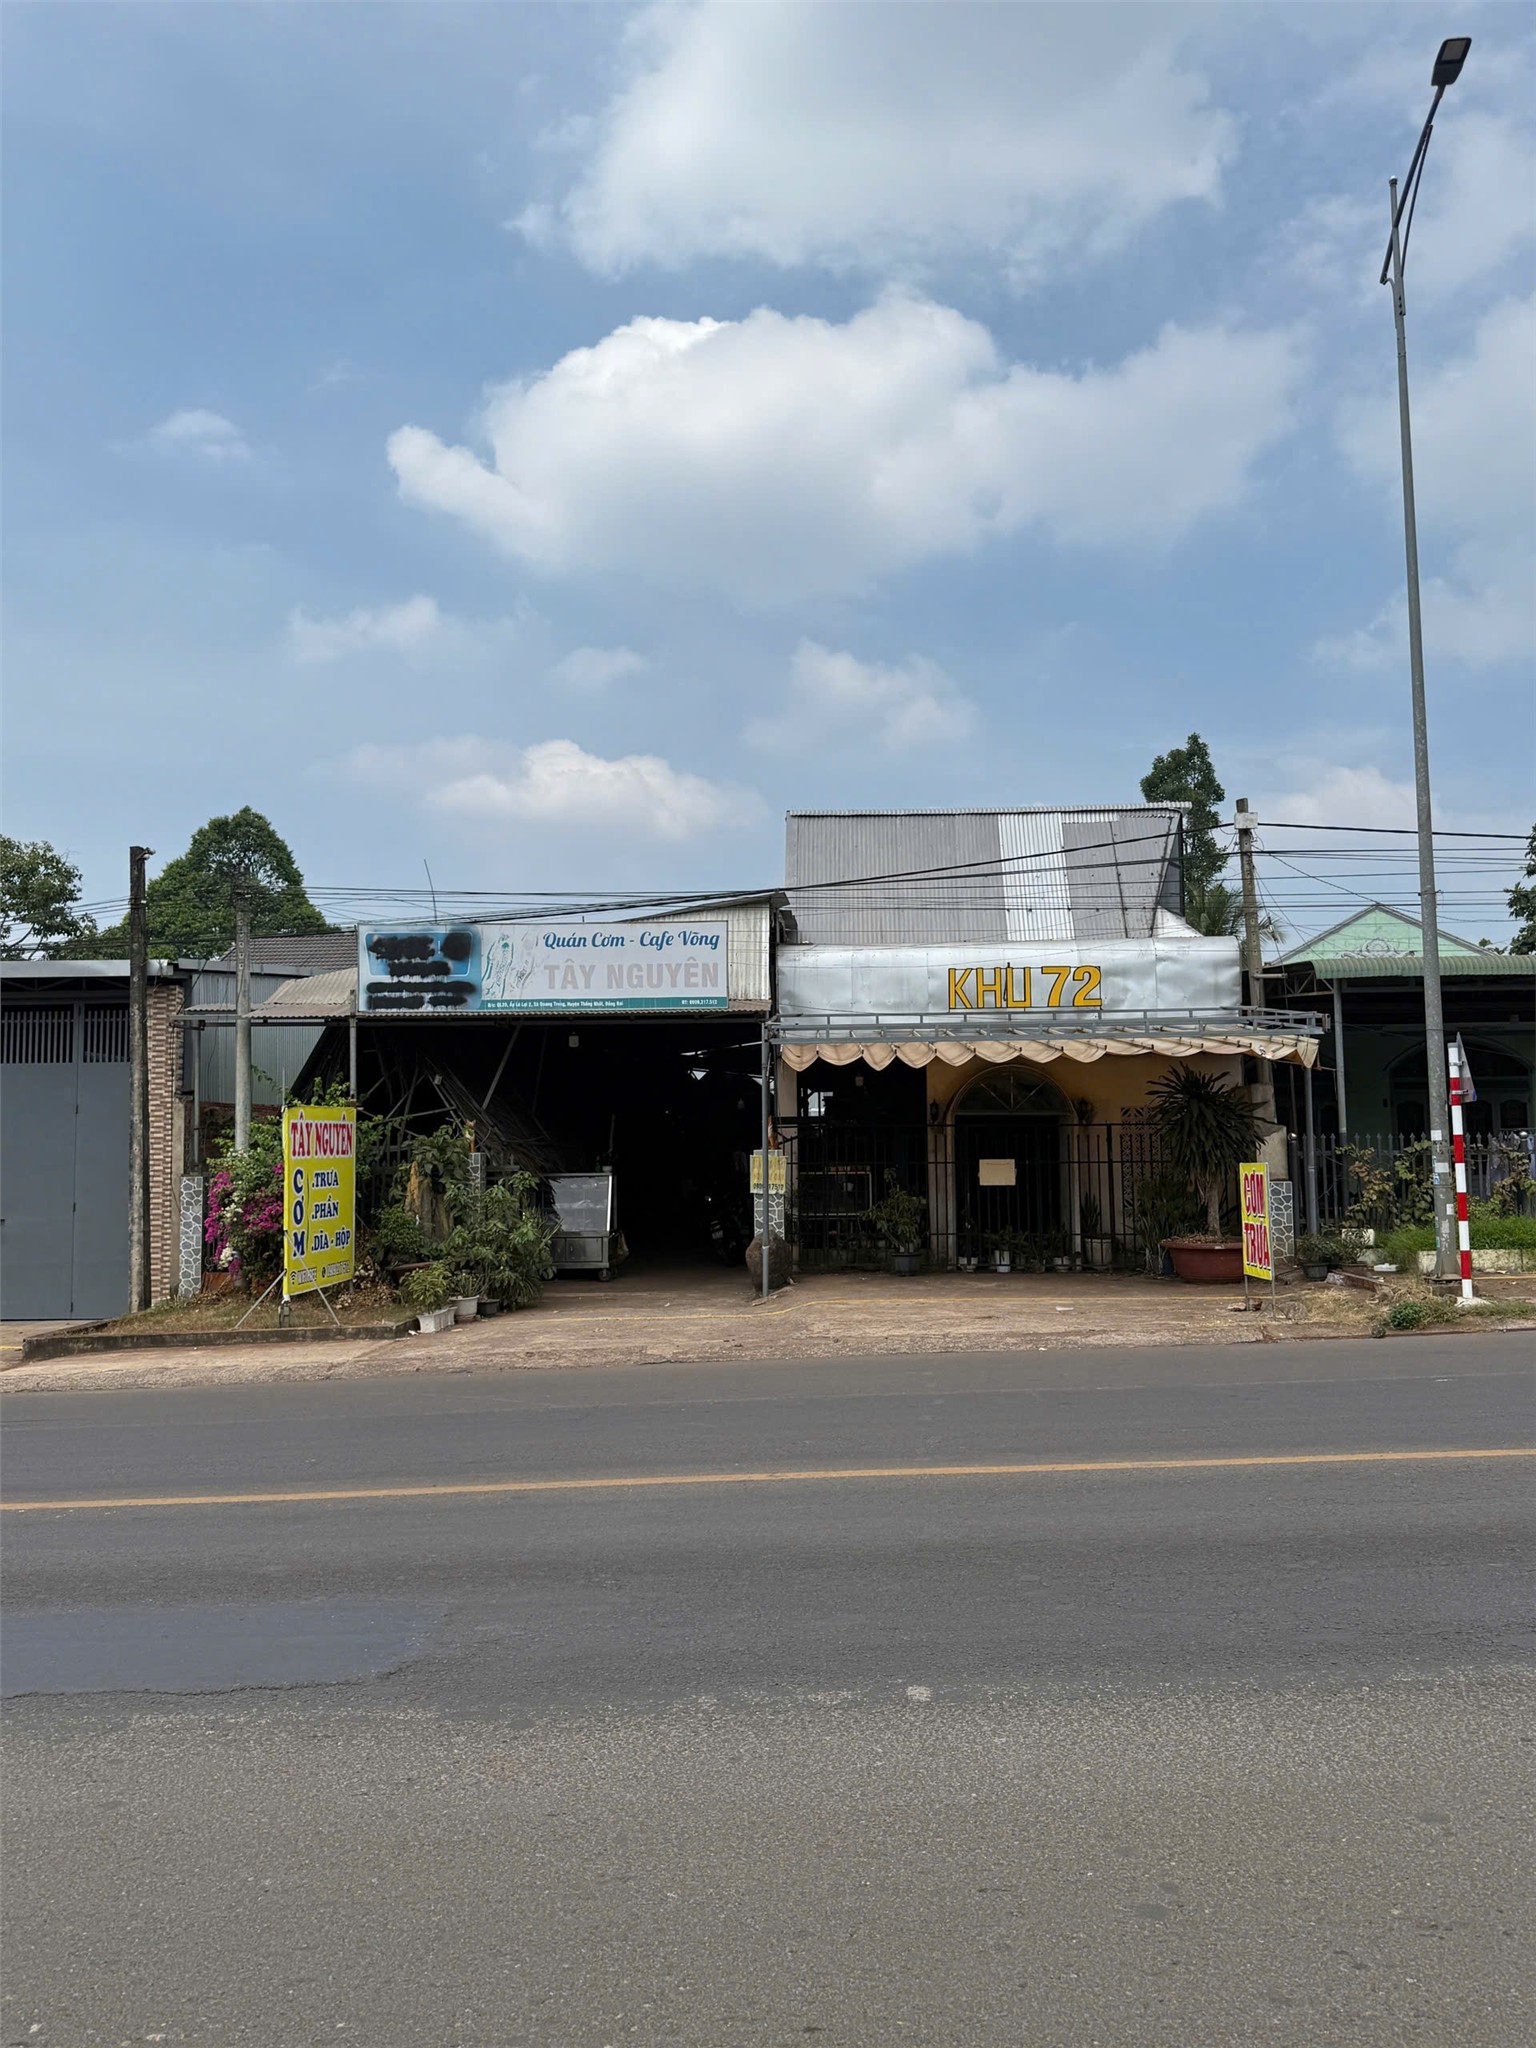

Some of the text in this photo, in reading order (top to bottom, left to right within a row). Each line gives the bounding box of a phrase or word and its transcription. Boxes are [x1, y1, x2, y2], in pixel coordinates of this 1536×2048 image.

[542, 931, 587, 949] Quán
[591, 932, 625, 947] Cơm
[639, 930, 674, 950] Cafe
[677, 930, 720, 950] Võng
[544, 956, 719, 989] TÂY NGUYÊN
[948, 965, 1102, 1008] KHU 72
[291, 1111, 353, 1157] TÂY NGUYÊN
[1244, 1169, 1266, 1217] CƠM
[335, 1227, 351, 1249] HỘP
[1244, 1220, 1271, 1269] TRƯA
